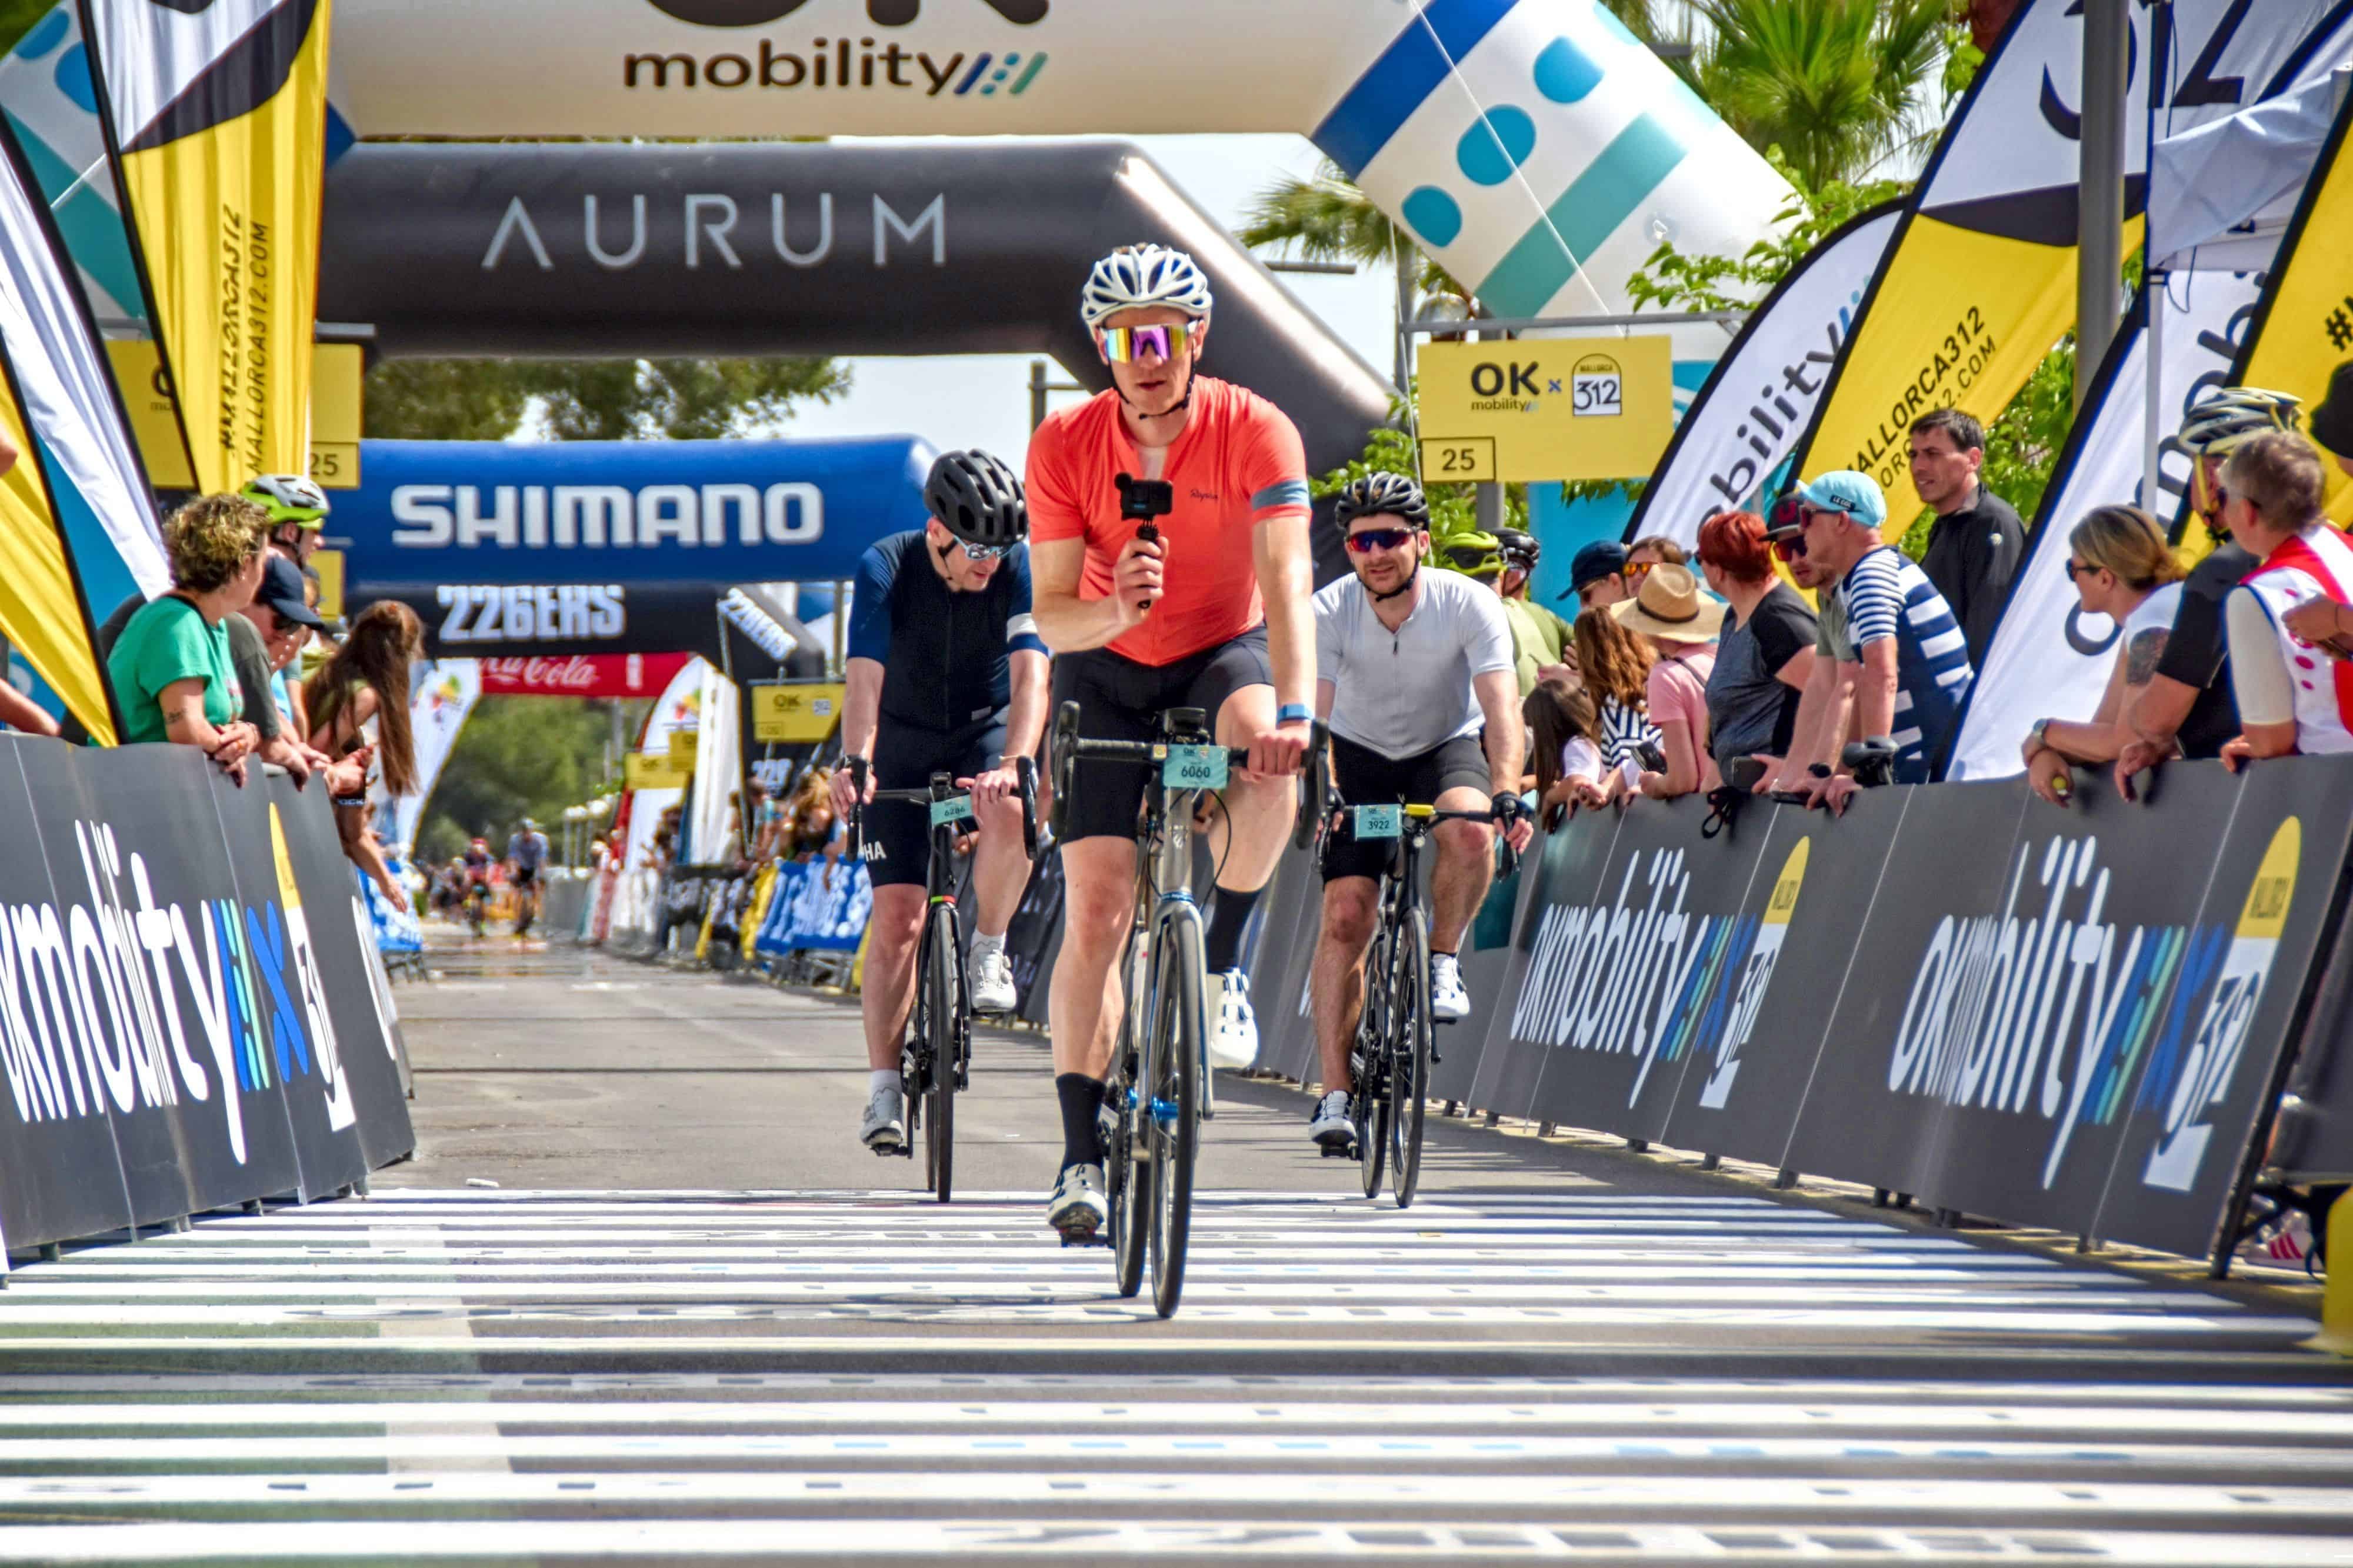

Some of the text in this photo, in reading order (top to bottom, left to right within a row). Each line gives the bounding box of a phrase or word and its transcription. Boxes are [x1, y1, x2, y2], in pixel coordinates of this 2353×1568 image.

[624, 37, 964, 96] mobility
[481, 192, 946, 269] AURUM
[1471, 361, 1540, 396] OK
[1471, 398, 1528, 412] mobility
[1573, 379, 1621, 411] 312
[309, 453, 338, 476] 25
[1442, 448, 1475, 472] 25
[391, 482, 823, 548] SHIMANO
[436, 584, 625, 642] 226ERS
[1181, 766, 1211, 778] 6060
[1368, 820, 1390, 830] 3922
